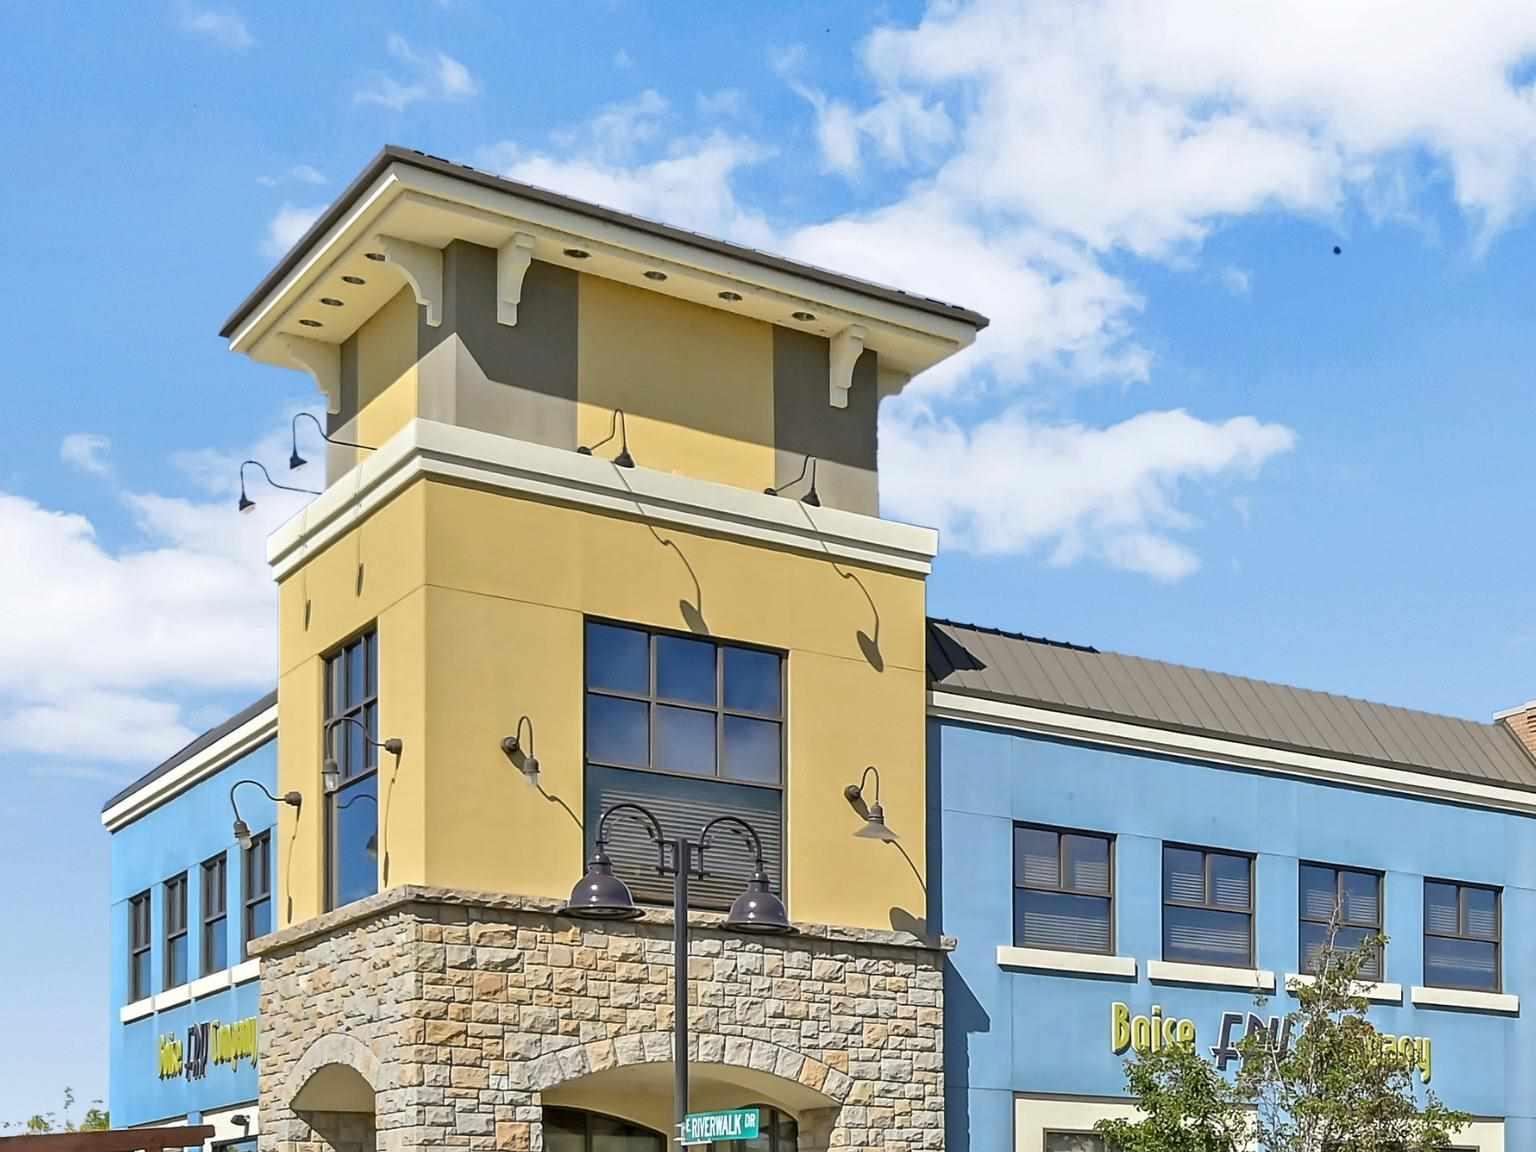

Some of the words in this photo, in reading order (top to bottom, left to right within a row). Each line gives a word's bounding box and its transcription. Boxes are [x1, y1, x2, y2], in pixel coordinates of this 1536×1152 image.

[1111, 1002, 1196, 1056] Boise
[685, 1118, 692, 1133] E
[691, 1113, 743, 1139] RIVERWALK
[744, 1113, 756, 1129] DR
